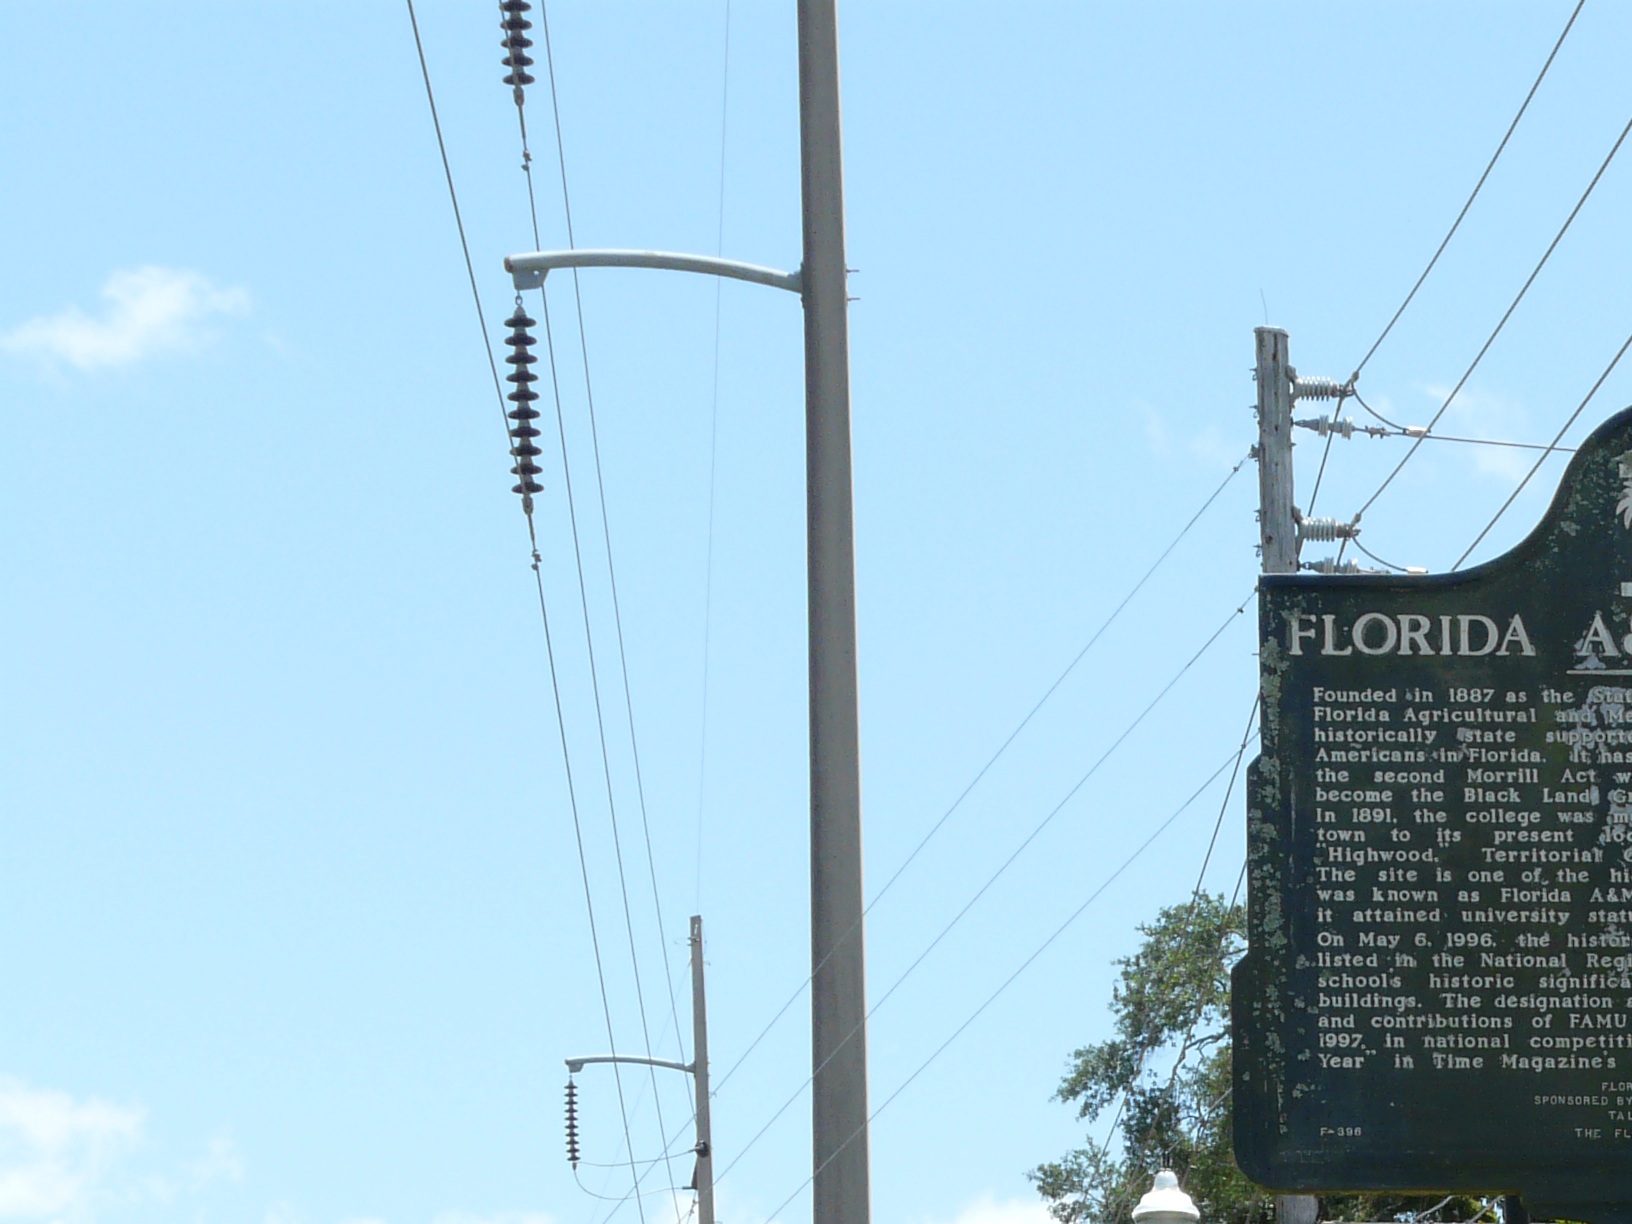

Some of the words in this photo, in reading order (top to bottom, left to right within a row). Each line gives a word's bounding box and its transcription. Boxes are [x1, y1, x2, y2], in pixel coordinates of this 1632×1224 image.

[1288, 612, 1535, 658] FLORIDA
[1313, 707, 1389, 722] Florida
[1404, 707, 1536, 726] Agricultural
[1556, 707, 1592, 722] and
[1314, 727, 1436, 747] historically
[1462, 727, 1515, 743] state
[1316, 768, 1349, 784] the
[1375, 768, 1444, 784] second
[1467, 768, 1538, 784] Morrill
[1562, 768, 1596, 784] Act
[1316, 787, 1392, 804] become
[1412, 787, 1443, 804] the
[1464, 787, 1520, 804] Black
[1543, 787, 1590, 804] Land
[1317, 827, 1365, 843] town
[1391, 827, 1410, 843] to
[1437, 827, 1460, 843] its
[1494, 827, 1573, 847] present
[1317, 908, 1332, 923] it
[1353, 908, 1441, 923] attained
[1462, 908, 1569, 927] university
[1430, 974, 1514, 989] historic
[1318, 993, 1422, 1013] buildings.
[1443, 993, 1480, 1009] The
[1494, 993, 1612, 1013] designation
[1394, 1053, 1413, 1069] in
[1434, 1053, 1483, 1069] Time
